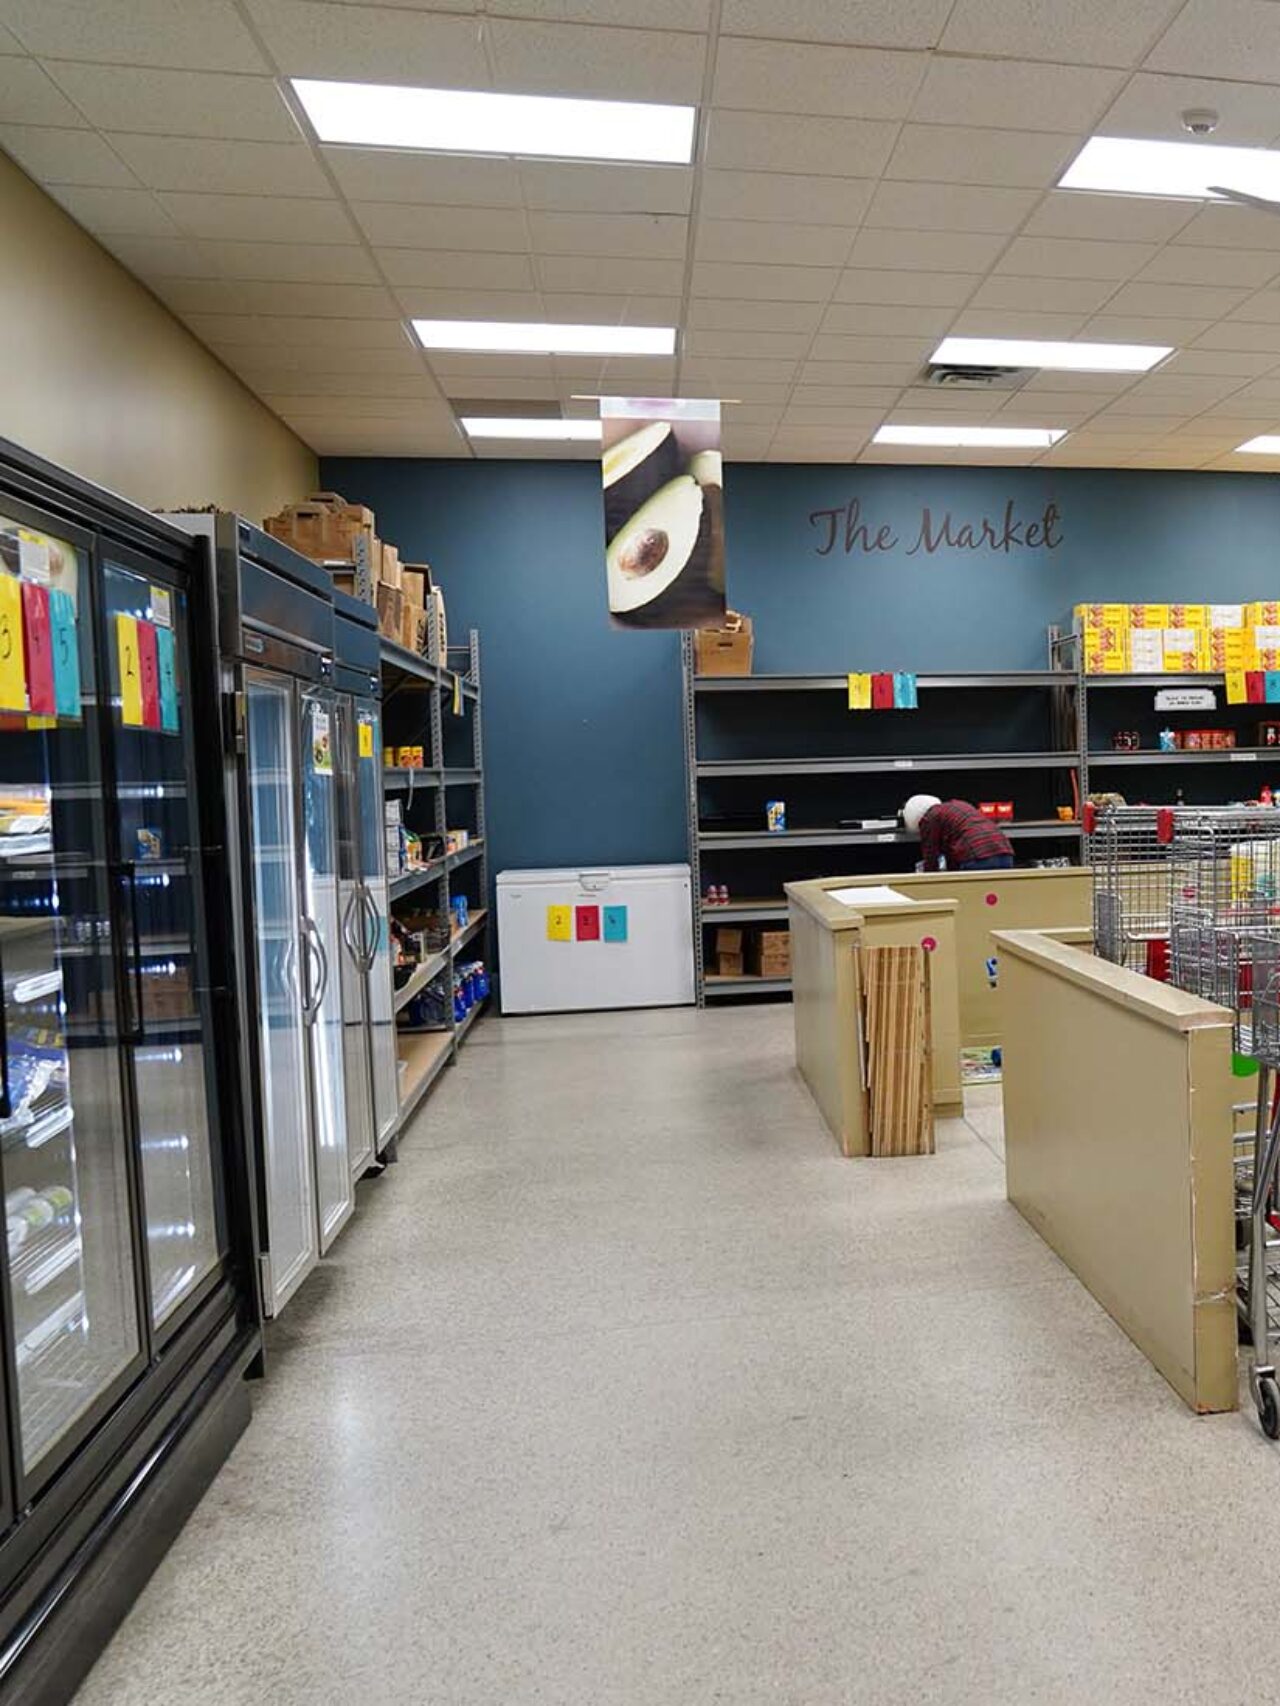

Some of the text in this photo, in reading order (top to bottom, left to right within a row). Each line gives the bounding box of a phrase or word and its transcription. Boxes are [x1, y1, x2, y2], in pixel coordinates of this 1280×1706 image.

[809, 498, 1064, 556] The Market
[59, 626, 70, 666] 5
